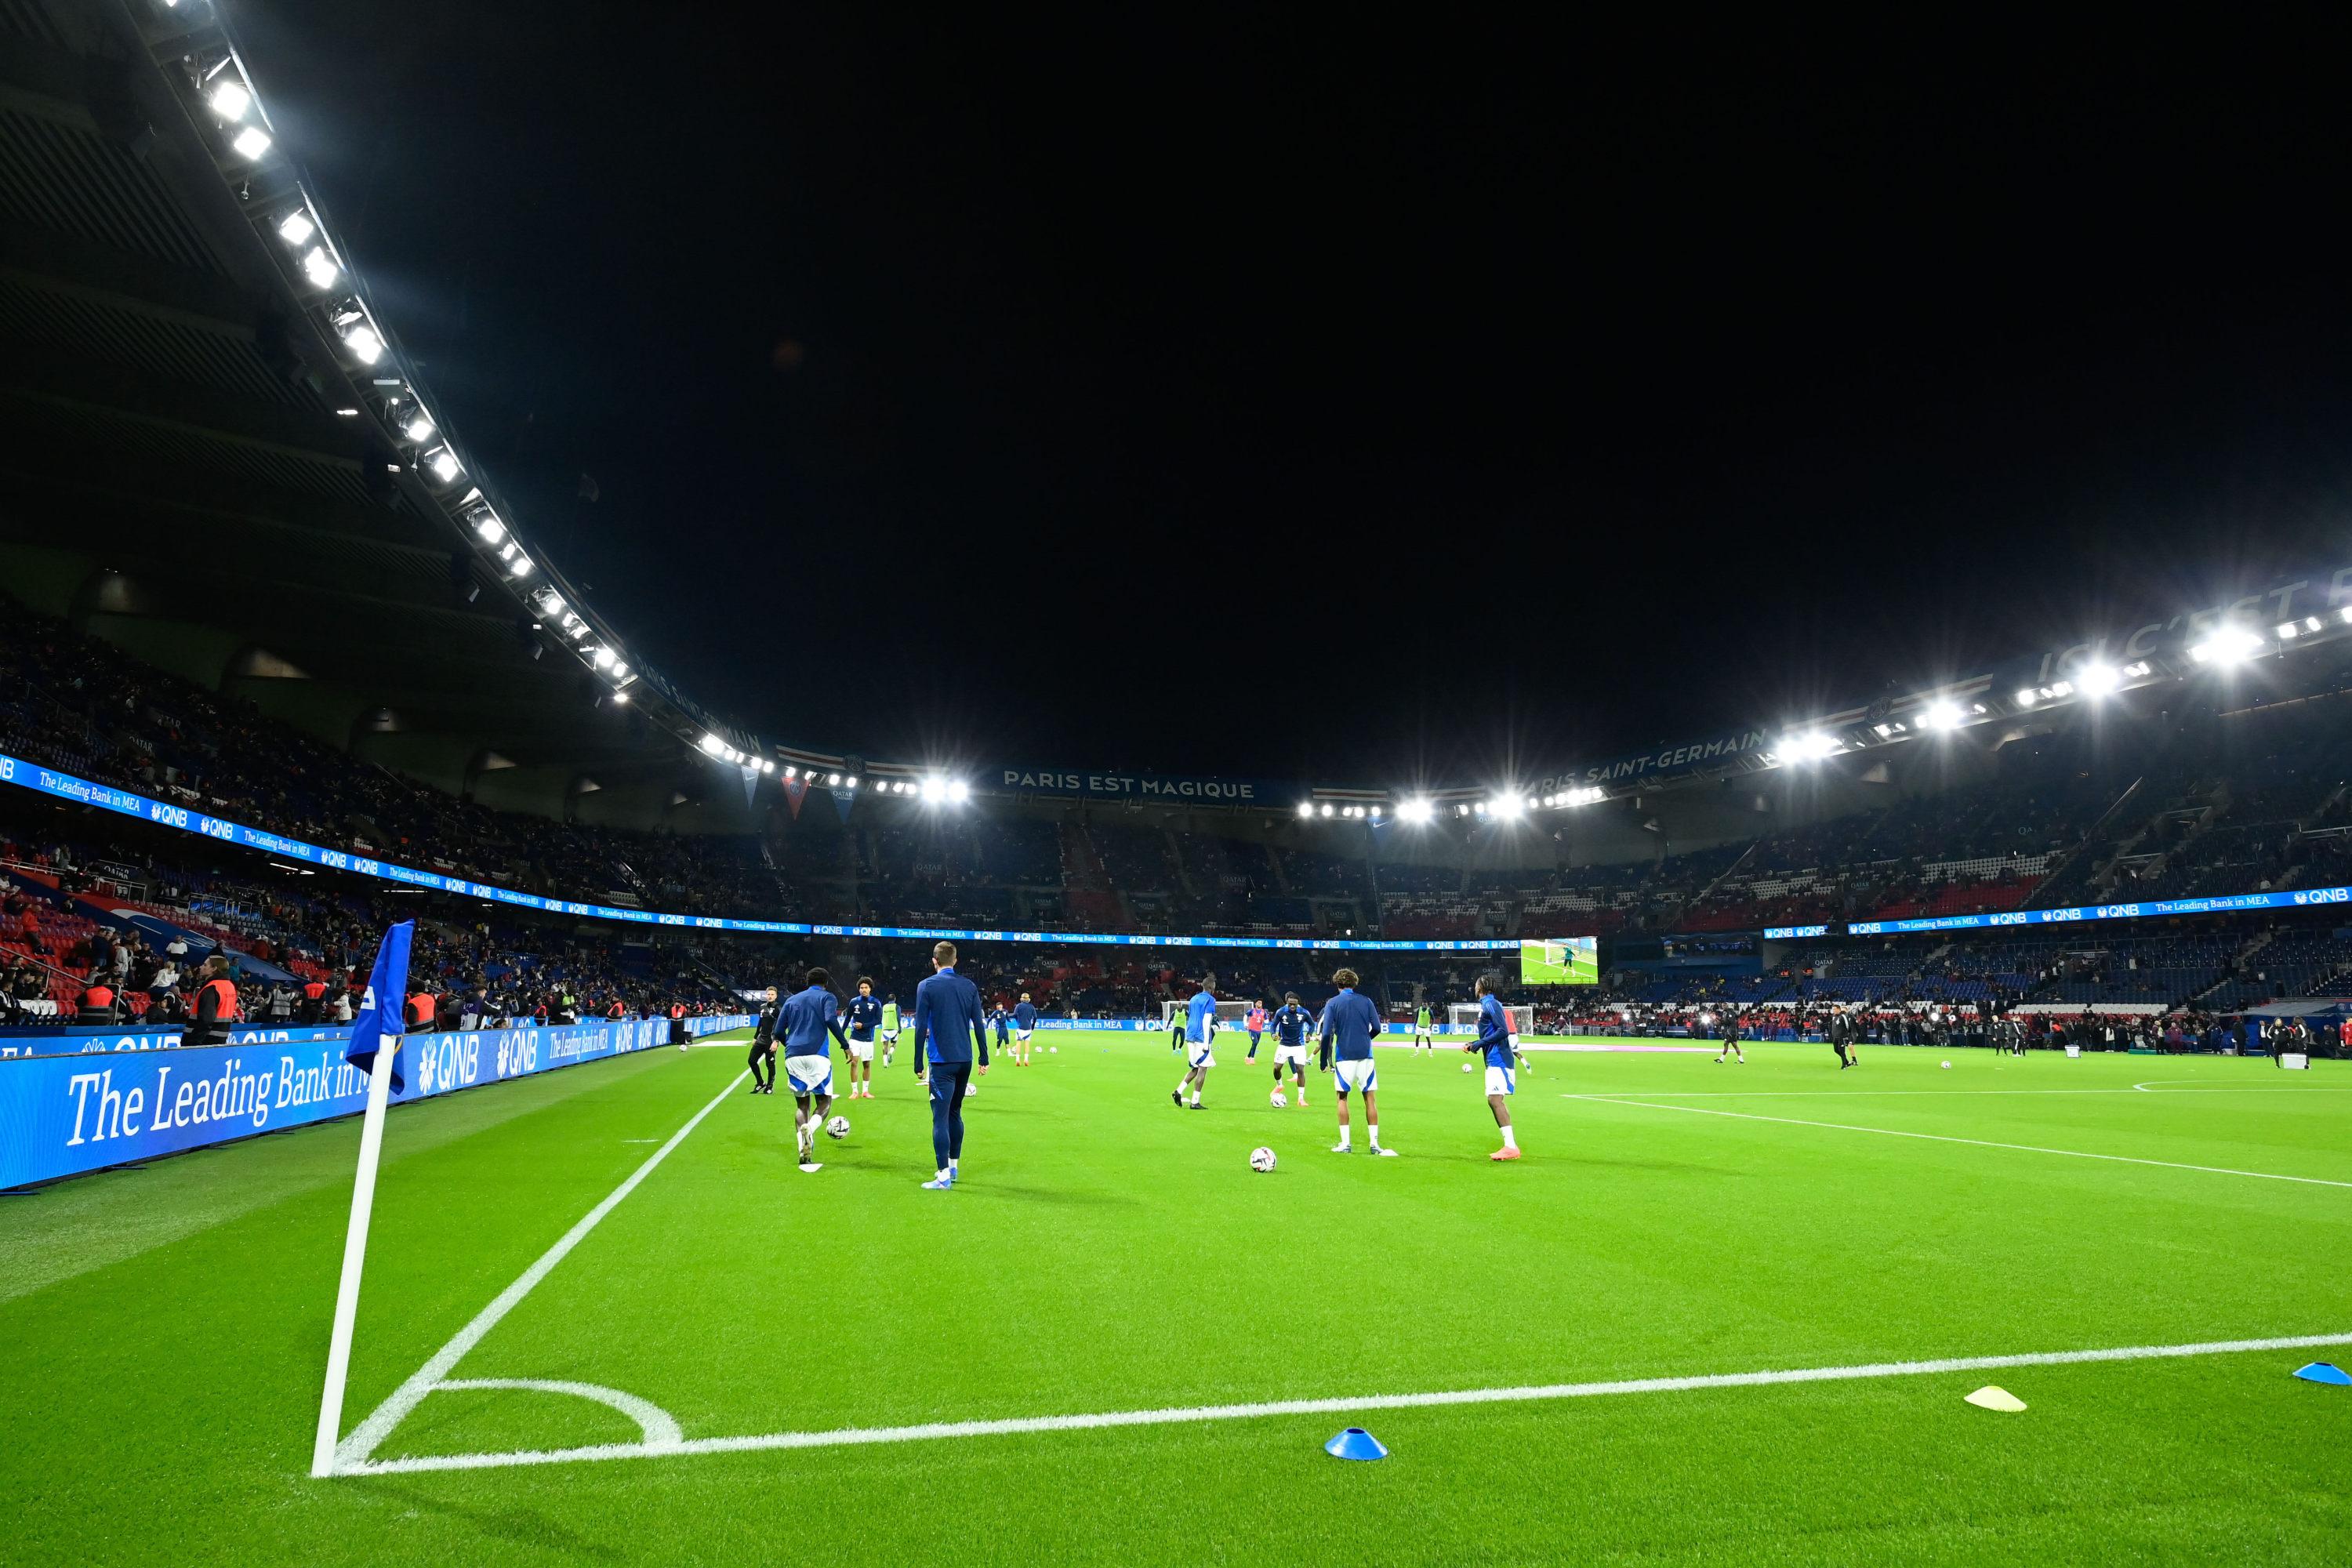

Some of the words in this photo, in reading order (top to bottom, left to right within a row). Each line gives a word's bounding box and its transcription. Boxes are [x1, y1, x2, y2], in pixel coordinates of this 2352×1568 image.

[1587, 728, 1768, 782] SAINT-GERMAIN
[40, 771, 56, 789] The
[57, 778, 90, 800] Leading
[90, 787, 111, 804] Bank
[112, 793, 120, 806] in
[122, 796, 140, 811] MEA
[1004, 771, 1080, 789] PARIS
[1089, 776, 1134, 792] EST
[1142, 780, 1254, 798] MAGIQUE
[162, 806, 187, 827] QNB
[209, 820, 233, 839] QNB
[245, 830, 256, 843] The
[256, 834, 277, 851] Leading
[278, 840, 292, 852] Bank
[292, 844, 297, 854] in
[298, 845, 310, 857] MEA
[328, 851, 347, 868] QNB
[361, 859, 378, 875] QNB
[389, 866, 397, 877] The
[397, 869, 414, 882] Leading
[414, 873, 426, 883] Bank
[430, 877, 440, 886] MEA
[451, 880, 466, 893] QNB
[477, 885, 492, 898] QNB
[2309, 888, 2348, 903] QNB
[549, 900, 562, 911] QNB
[573, 903, 588, 915] QNB
[2108, 904, 2140, 917] QNB
[2155, 903, 2172, 912] The
[2174, 900, 2209, 912] Leading
[2210, 898, 2233, 908] Bank
[2234, 898, 2245, 906] in
[2246, 896, 2270, 905] MEA
[605, 909, 622, 919] Leading
[666, 914, 684, 924] QNB
[1999, 913, 2027, 924] QNB
[2053, 909, 2082, 921] QNB
[703, 918, 722, 928] QNB
[743, 922, 765, 931] Leading
[1858, 924, 1881, 934] QNB
[1911, 920, 1936, 930] Leading
[1936, 919, 1954, 927] Bank
[1962, 916, 1979, 925] MEA
[821, 926, 843, 935] QNB
[860, 927, 881, 936] QNB
[909, 930, 930, 938] Leading
[1773, 928, 1793, 938] QNB
[1136, 936, 1156, 945] QNB
[1283, 939, 1302, 948] QNB
[1041, 1021, 1072, 1030] Leading
[620, 1022, 633, 1050] QNB
[550, 1033, 561, 1059] The
[561, 1029, 582, 1060] Leading
[581, 1028, 593, 1054] Bank
[593, 1029, 598, 1051] in
[598, 1028, 608, 1050] MEA
[510, 1030, 538, 1075] QNB
[437, 1034, 480, 1091] QNB
[67, 1069, 143, 1147] The
[150, 1058, 274, 1127] Leading
[275, 1051, 334, 1109] Bank
[334, 1051, 354, 1098] in
